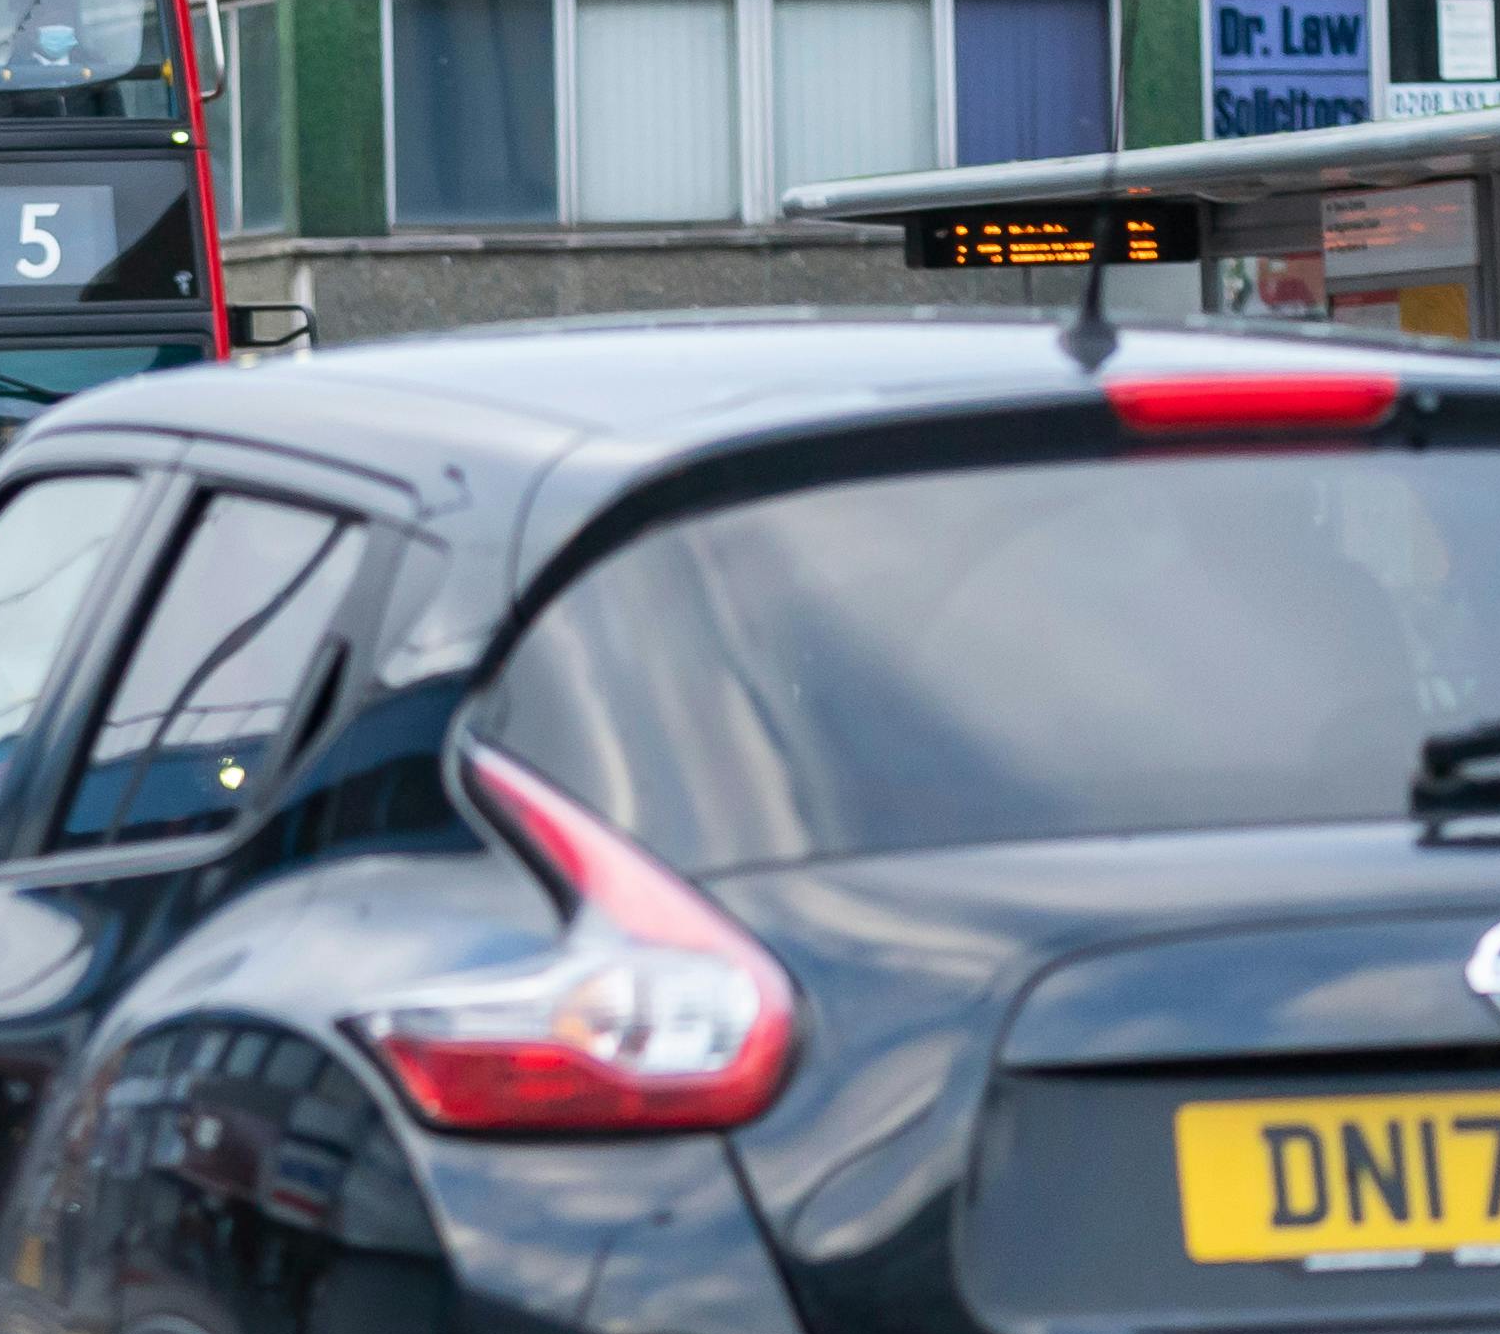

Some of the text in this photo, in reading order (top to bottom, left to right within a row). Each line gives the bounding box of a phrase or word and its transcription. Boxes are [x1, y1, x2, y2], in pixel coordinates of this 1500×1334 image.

[1219, 5, 1360, 58] Dr. Law
[15, 203, 62, 279] 5
